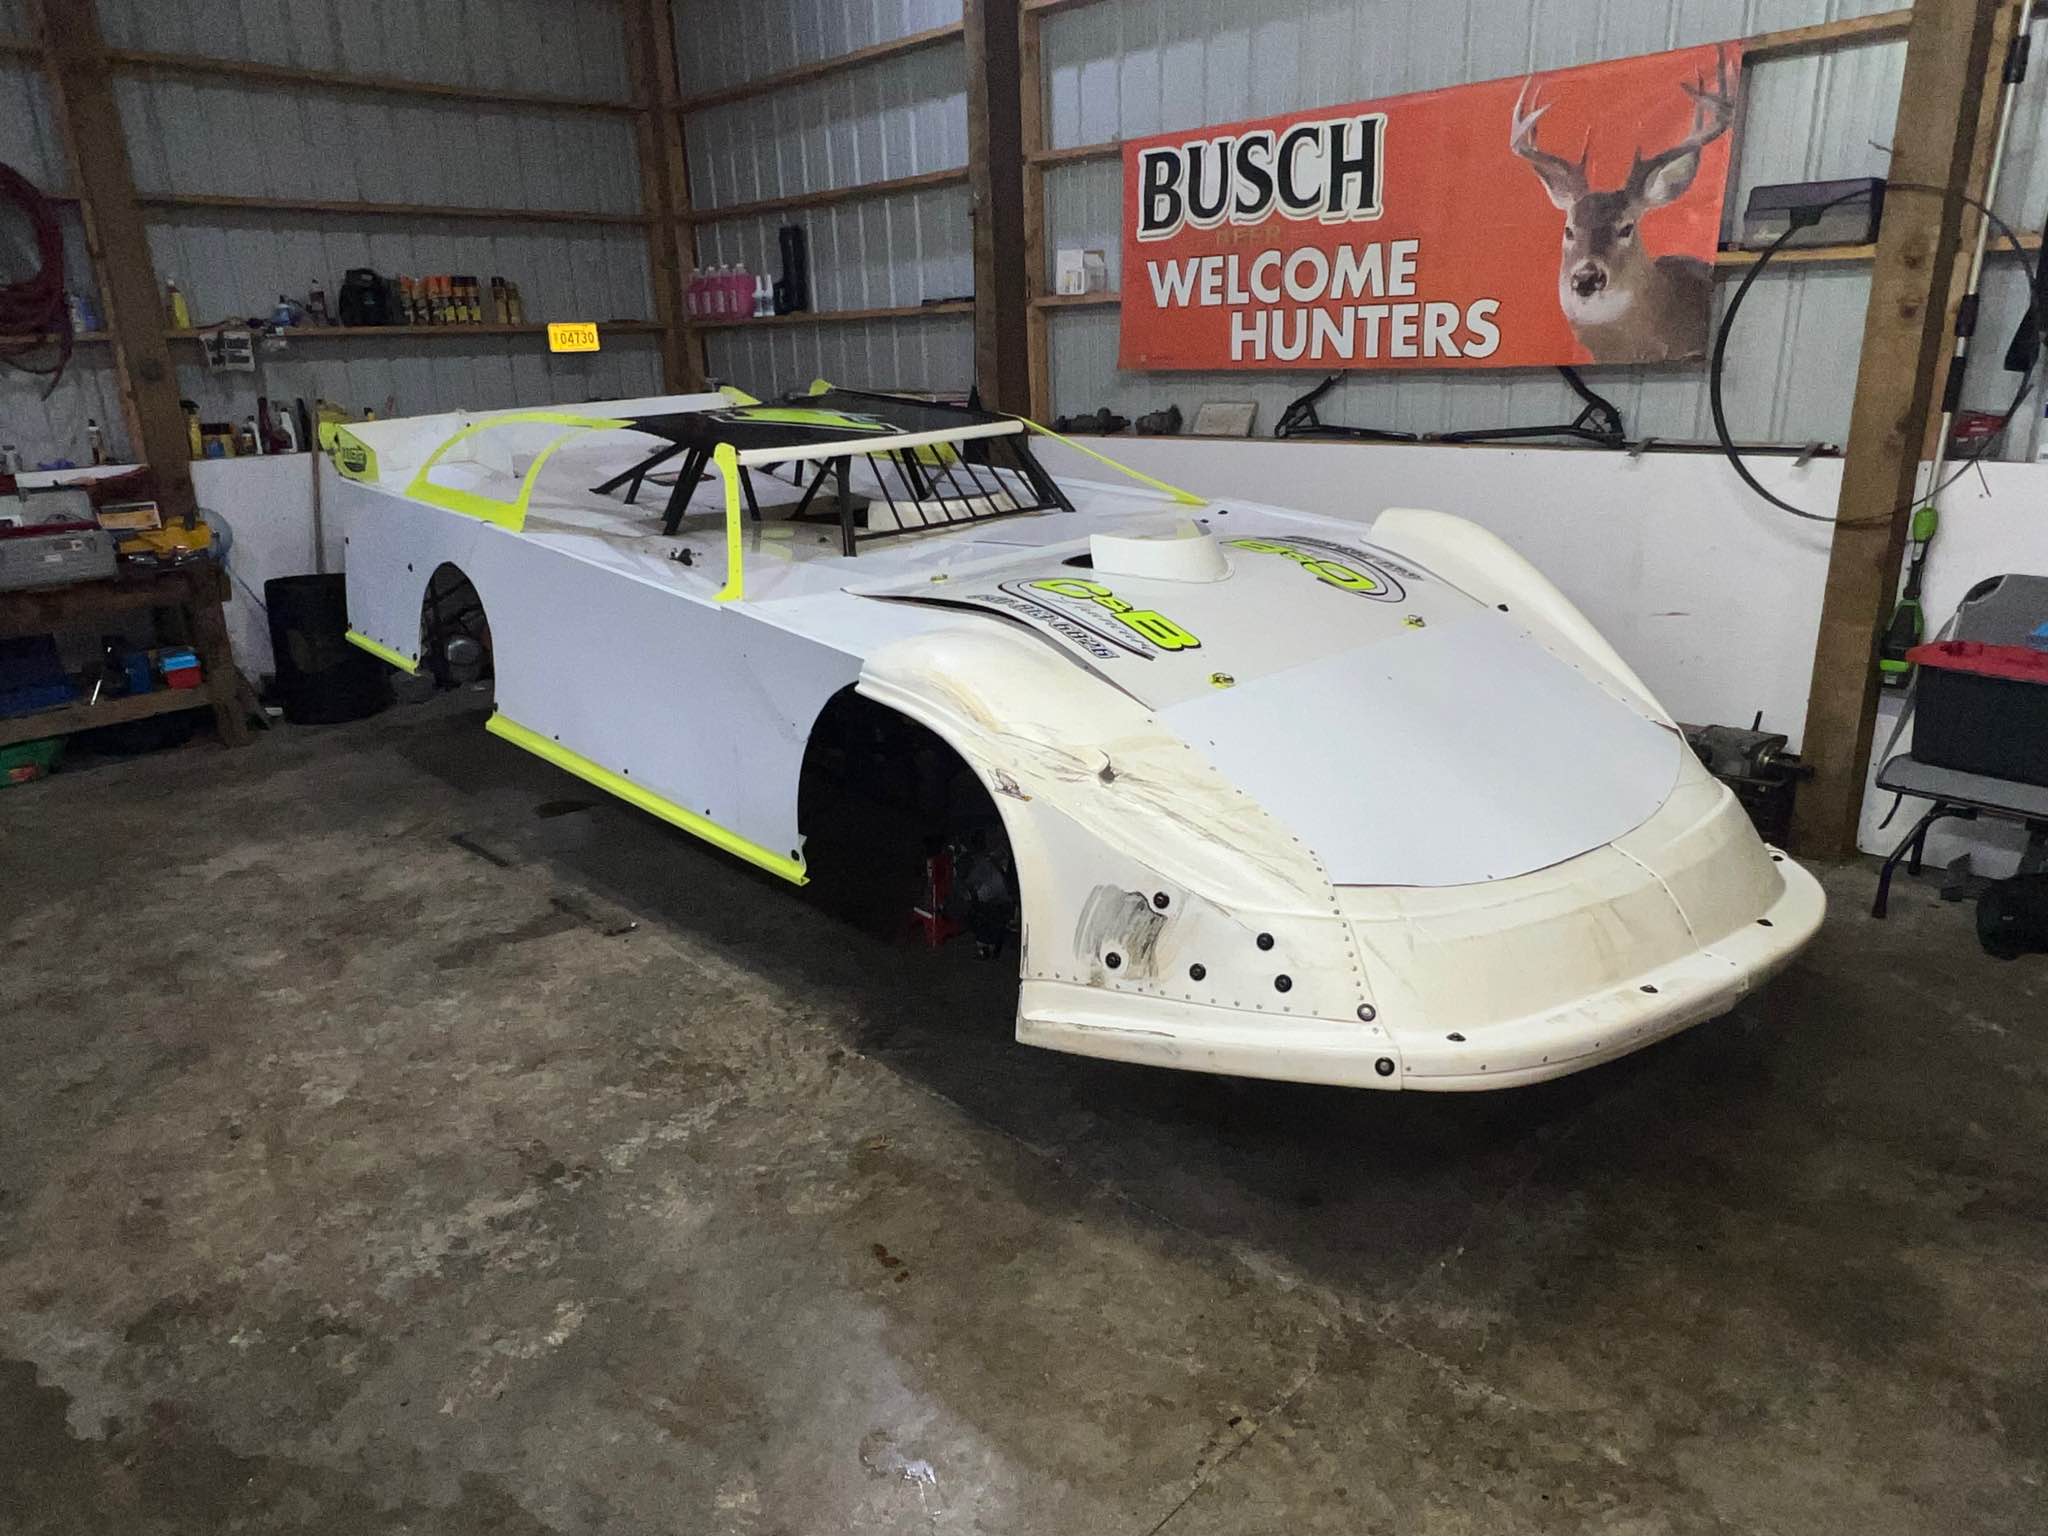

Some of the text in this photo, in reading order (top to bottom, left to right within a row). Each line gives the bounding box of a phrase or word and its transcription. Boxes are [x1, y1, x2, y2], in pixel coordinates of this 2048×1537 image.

[1139, 115, 1385, 237] BUSCH
[1146, 239, 1420, 309] WELCOME
[560, 332, 594, 345] 04730
[1231, 298, 1501, 361] HUNTERS
